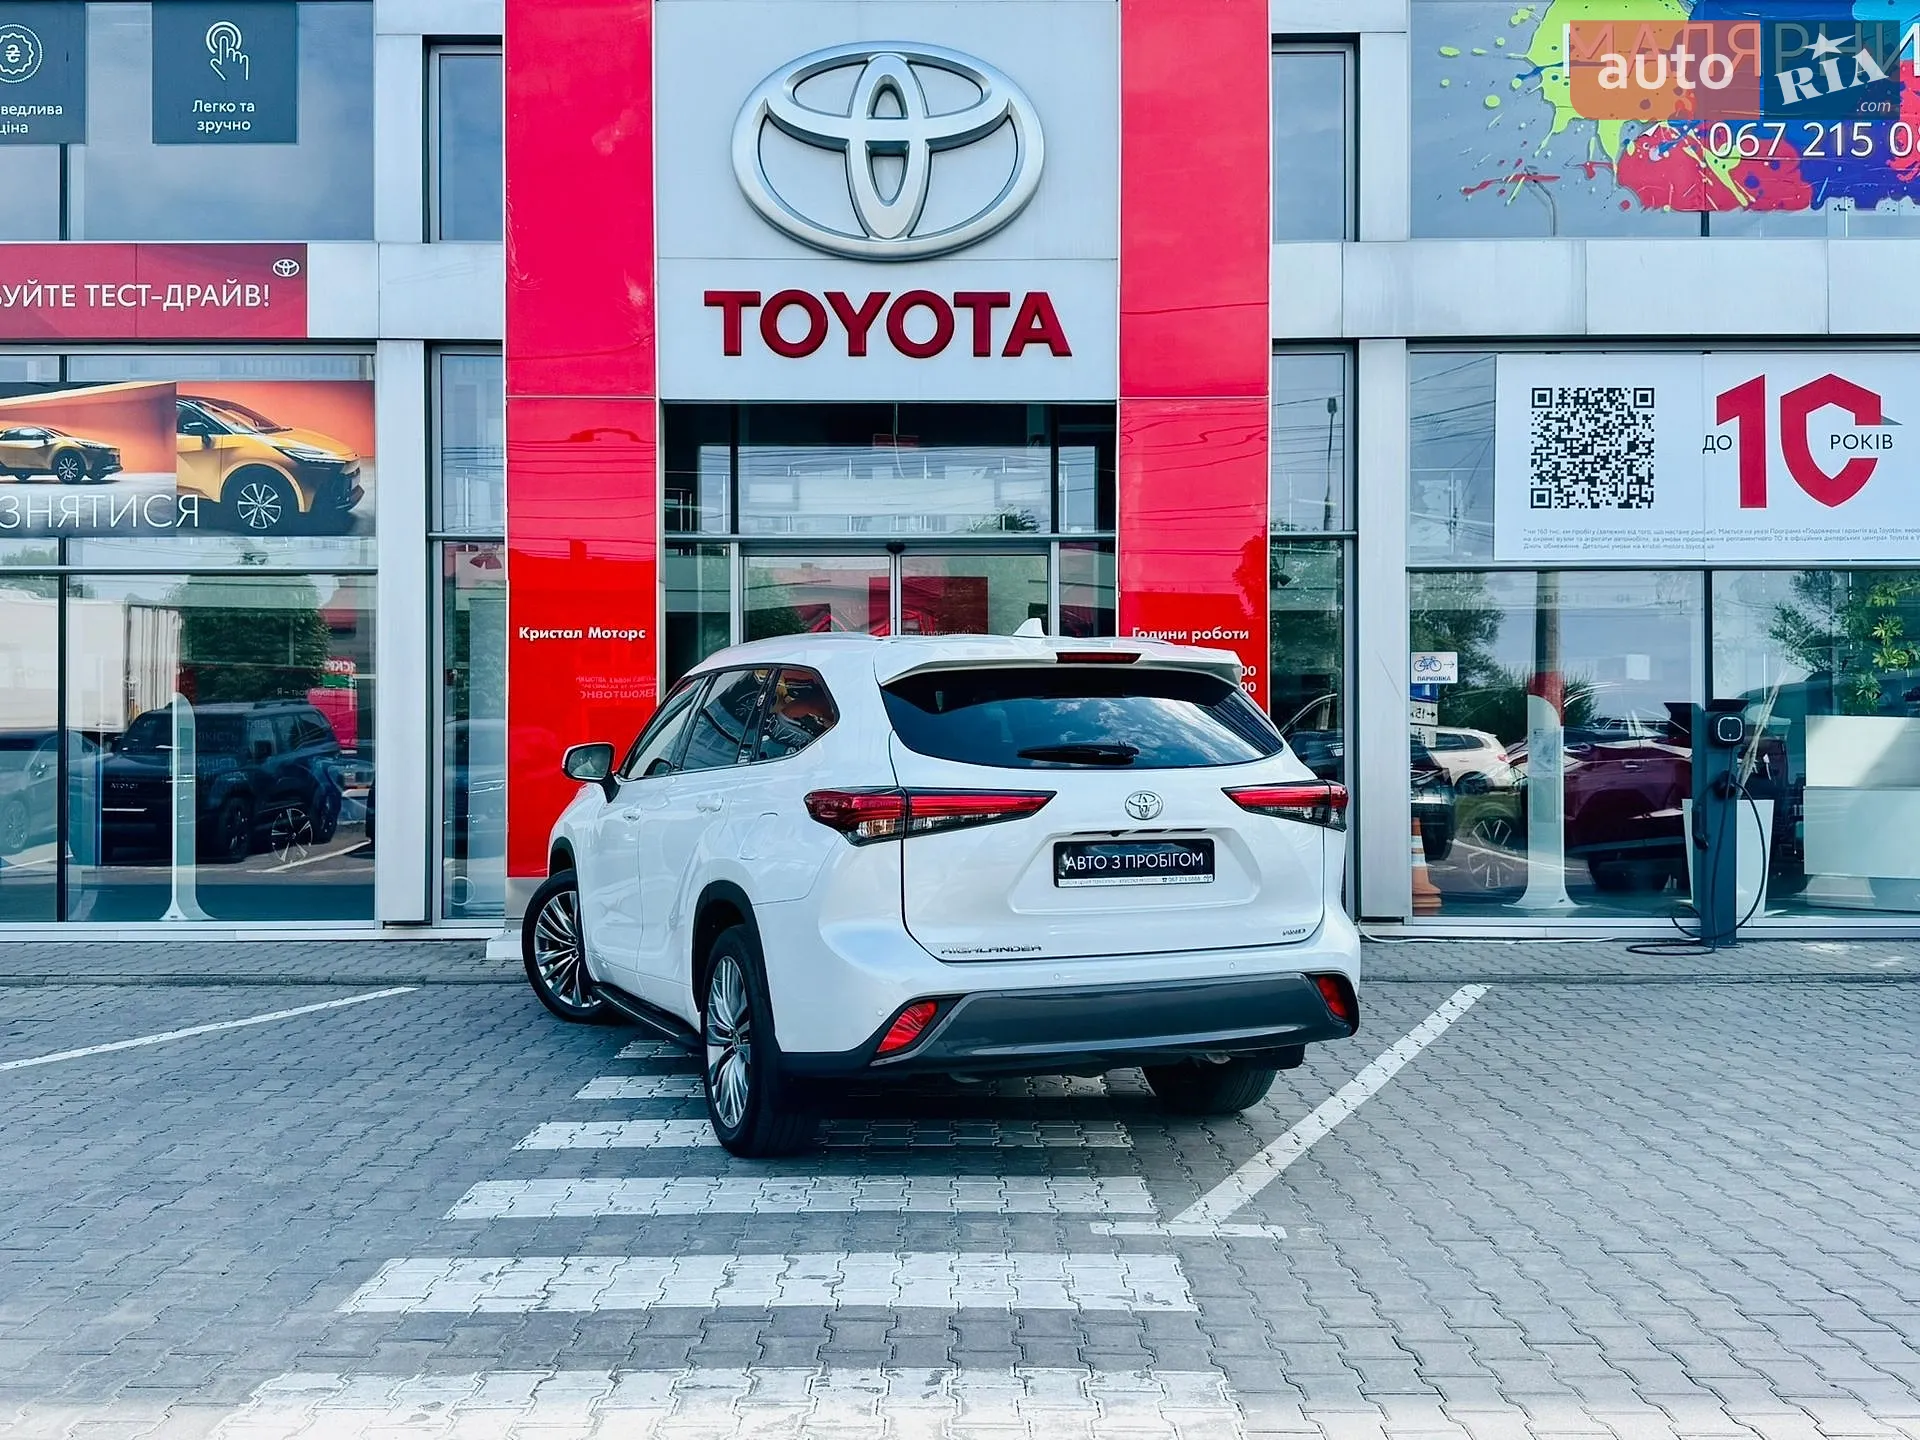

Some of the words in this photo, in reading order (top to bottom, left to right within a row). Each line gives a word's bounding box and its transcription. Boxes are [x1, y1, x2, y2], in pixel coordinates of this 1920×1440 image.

[192, 100, 236, 115] Легко
[238, 101, 255, 114] та
[197, 118, 251, 133] зручно
[1709, 122, 1786, 157] 067
[1803, 122, 1873, 157] 215
[0, 279, 76, 308] УЙТЕ
[84, 279, 271, 310] ТЕСТ-ДРАЙВ!
[704, 289, 1073, 359] TOYOTA
[1702, 434, 1732, 454] ДО
[1829, 434, 1893, 450] РОКІВ
[0, 494, 200, 528] ЗНЯТИСЯ
[518, 626, 583, 642] Кристал
[587, 626, 646, 642] Моторс
[1132, 627, 1187, 641] Години
[1191, 626, 1249, 643] роботи
[1065, 855, 1107, 871] АВТО
[1111, 855, 1121, 869] З
[1125, 852, 1204, 869] ПРОБІГОМ
[941, 945, 1042, 954] HIGHLANDER
